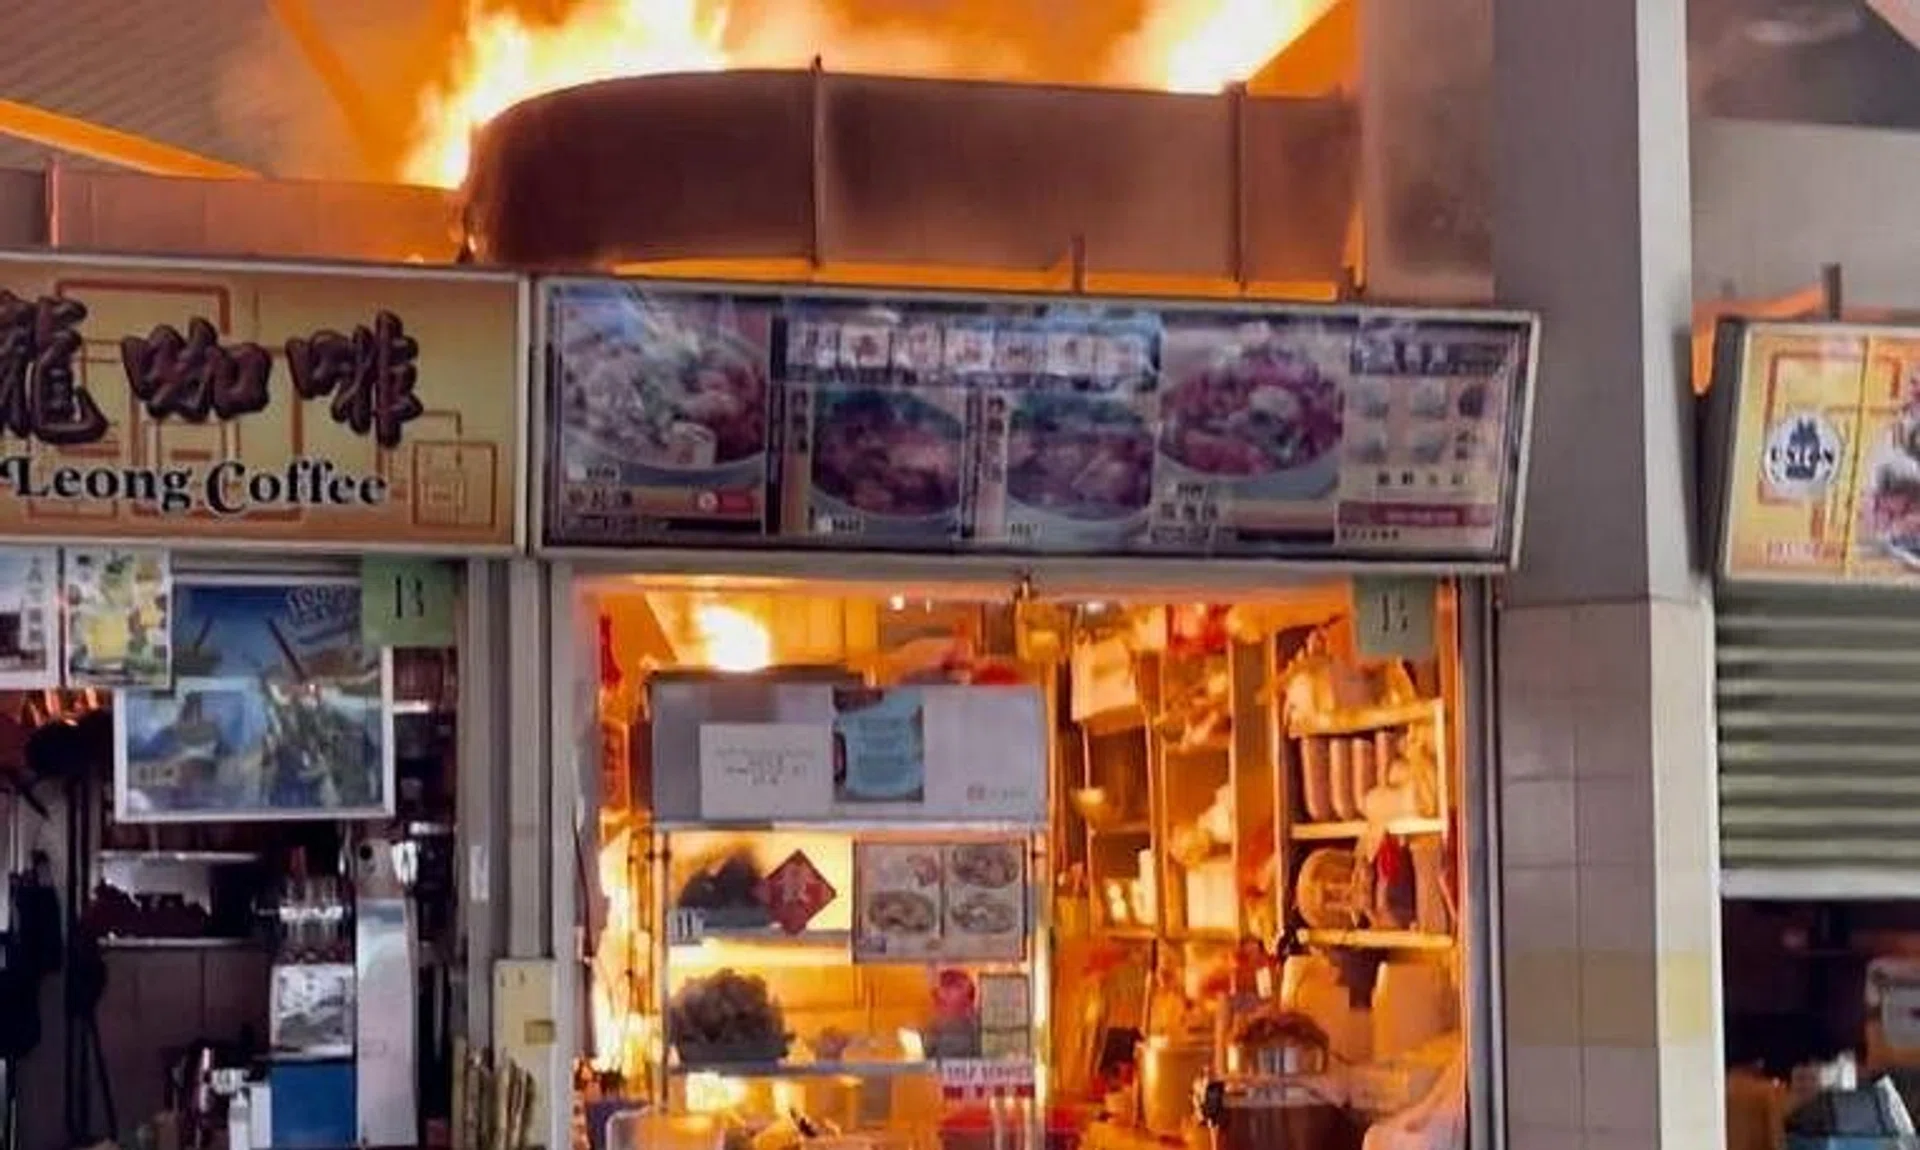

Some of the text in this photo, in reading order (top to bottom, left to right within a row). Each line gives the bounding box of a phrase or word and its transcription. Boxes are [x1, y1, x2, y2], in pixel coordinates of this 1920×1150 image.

[0, 455, 387, 514] Leong Coffee
[395, 575, 425, 619] 13
